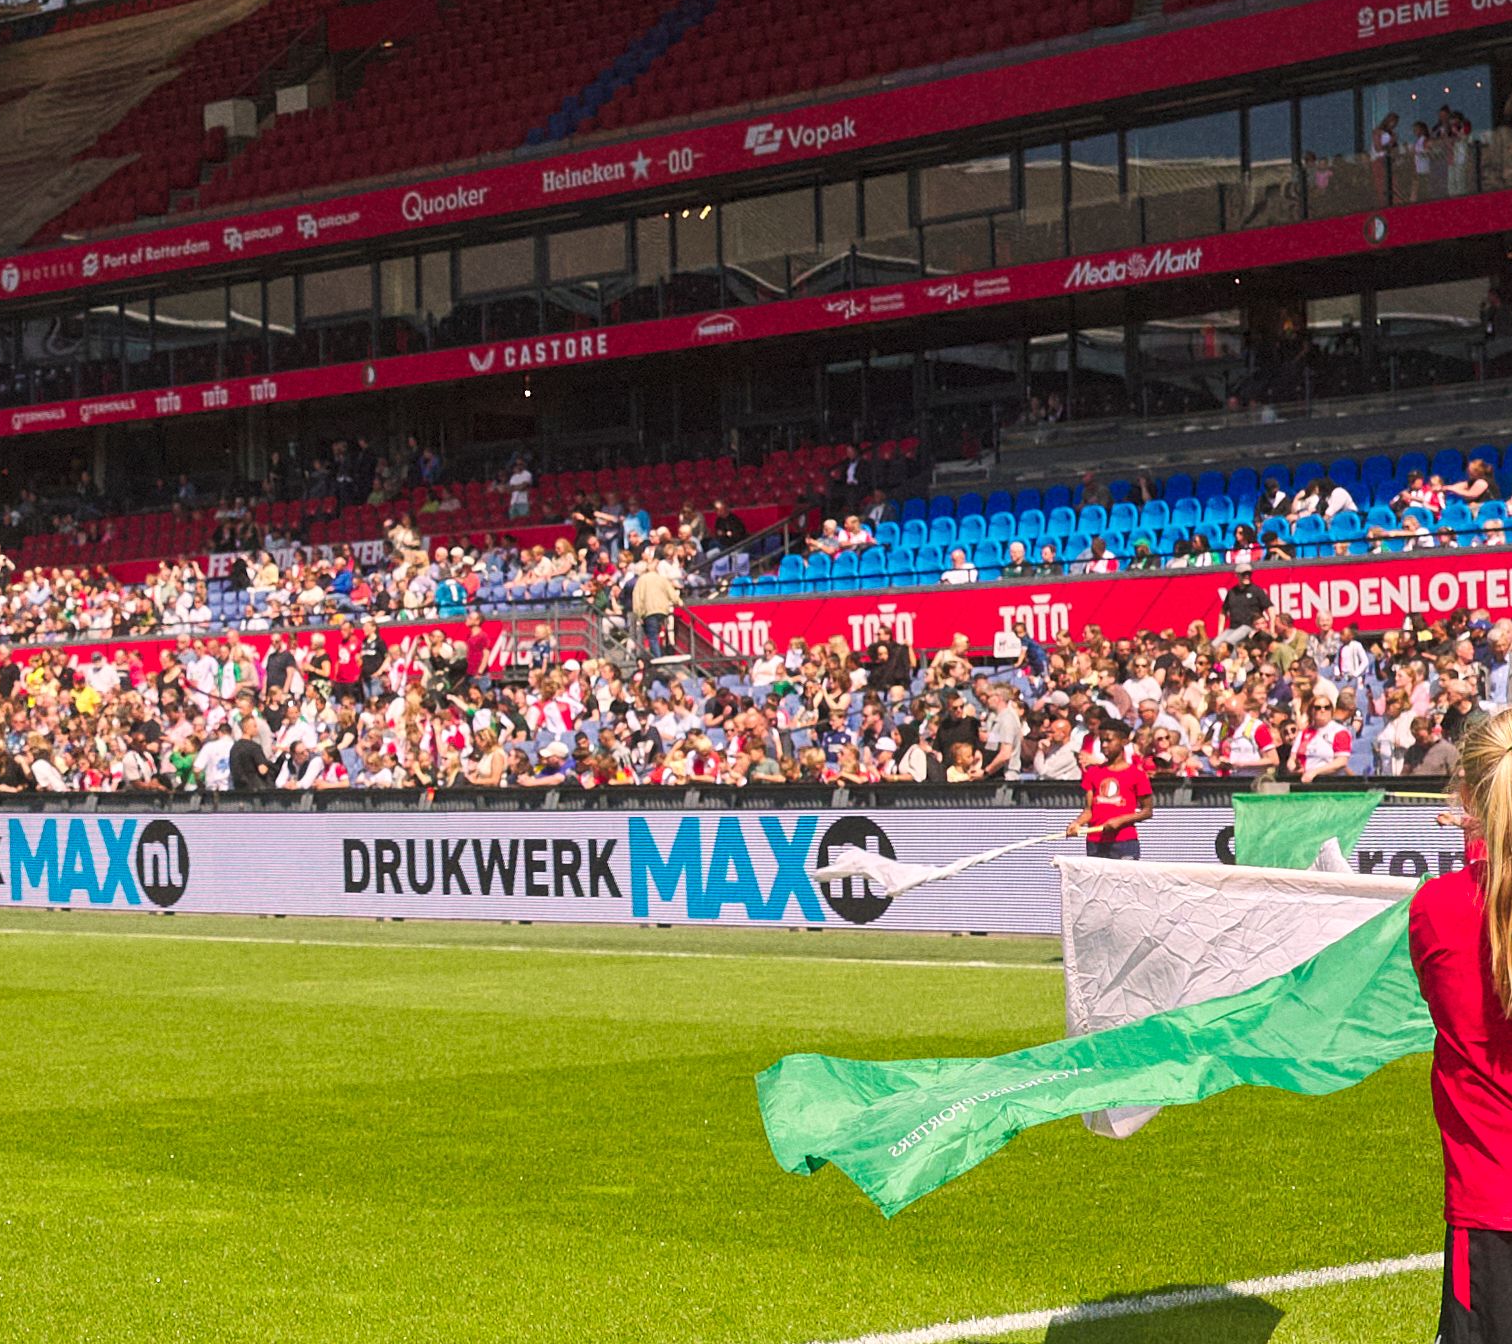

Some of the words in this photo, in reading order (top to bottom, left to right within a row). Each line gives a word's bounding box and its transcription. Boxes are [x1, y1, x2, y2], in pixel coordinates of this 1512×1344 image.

[785, 116, 857, 149] Vopak
[542, 162, 626, 193] Heineken
[318, 212, 360, 230] GROUP
[402, 185, 489, 222] Quooker
[102, 254, 127, 269] Port
[130, 249, 144, 264] of
[144, 239, 211, 261] Rotterdam
[504, 334, 608, 367] CASTORE
[707, 612, 770, 657] TOTO
[847, 604, 914, 652] TOTO
[997, 594, 1070, 644] TOTO
[8, 818, 143, 906] MAX
[343, 838, 623, 898] DRUKWERK
[627, 816, 828, 922] MAX
